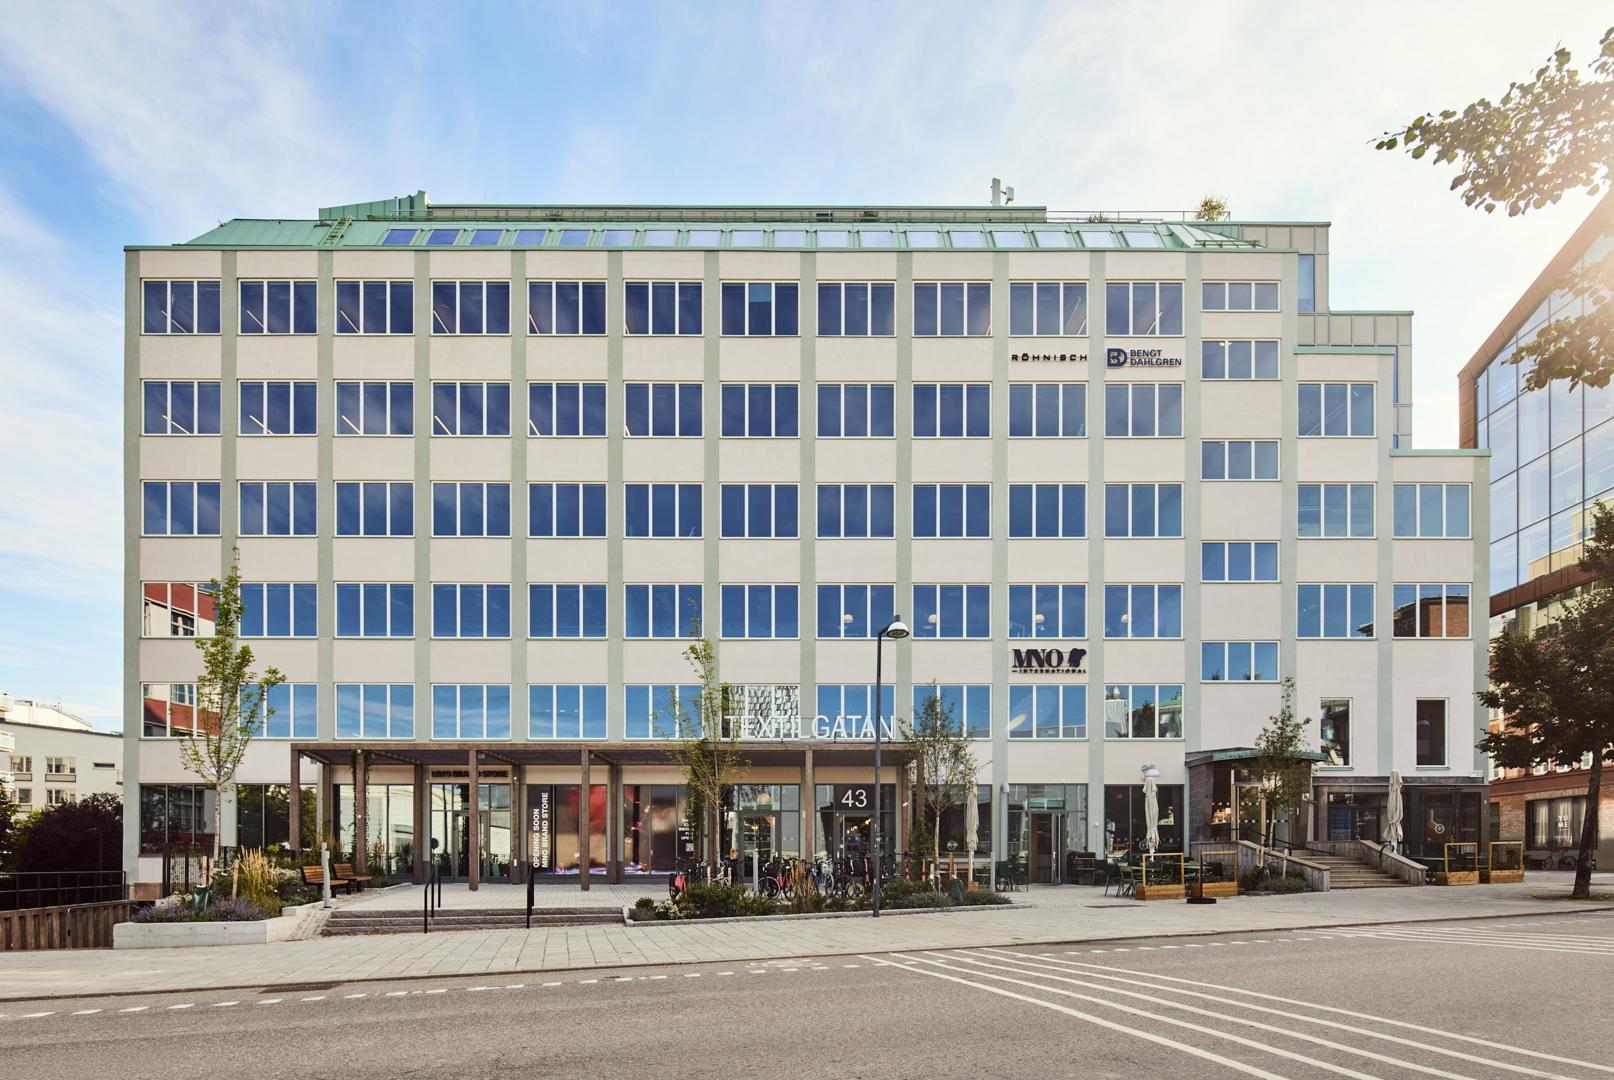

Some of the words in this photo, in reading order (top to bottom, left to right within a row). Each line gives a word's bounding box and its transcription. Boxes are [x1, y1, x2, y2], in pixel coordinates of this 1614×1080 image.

[1012, 353, 1087, 361] RÖHNISCH
[1130, 349, 1162, 357] BENGT
[1130, 358, 1182, 366] DAHLGREN
[1012, 649, 1064, 668] MNO
[724, 715, 894, 739] TEXTILGATAN
[541, 792, 549, 819] STORE
[841, 789, 867, 807] 43
[541, 820, 549, 848] BRAND
[541, 849, 549, 868] MNO
